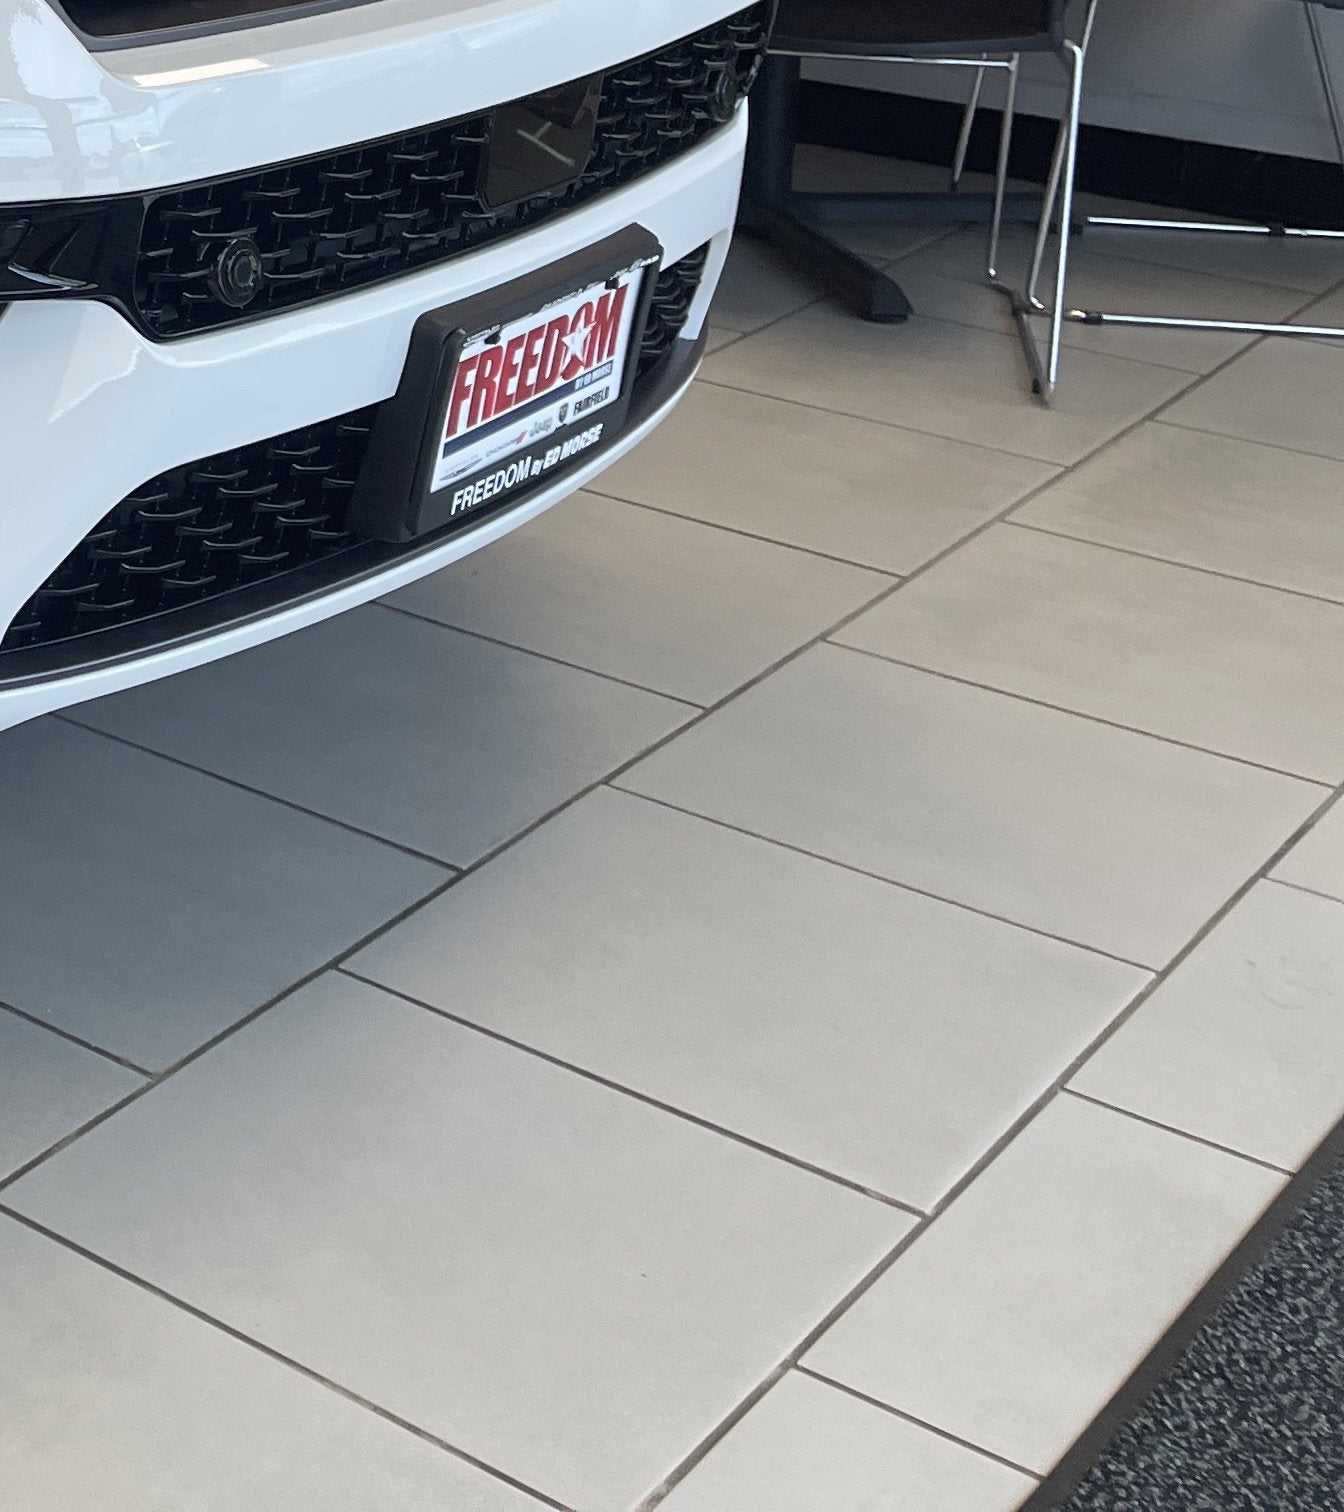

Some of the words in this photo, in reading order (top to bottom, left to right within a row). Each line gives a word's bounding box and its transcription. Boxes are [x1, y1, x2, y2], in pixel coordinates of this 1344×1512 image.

[445, 282, 630, 439] FREEDOM
[451, 456, 532, 516] FREEDOM
[542, 445, 562, 470] ED
[560, 423, 604, 461] MORSE
